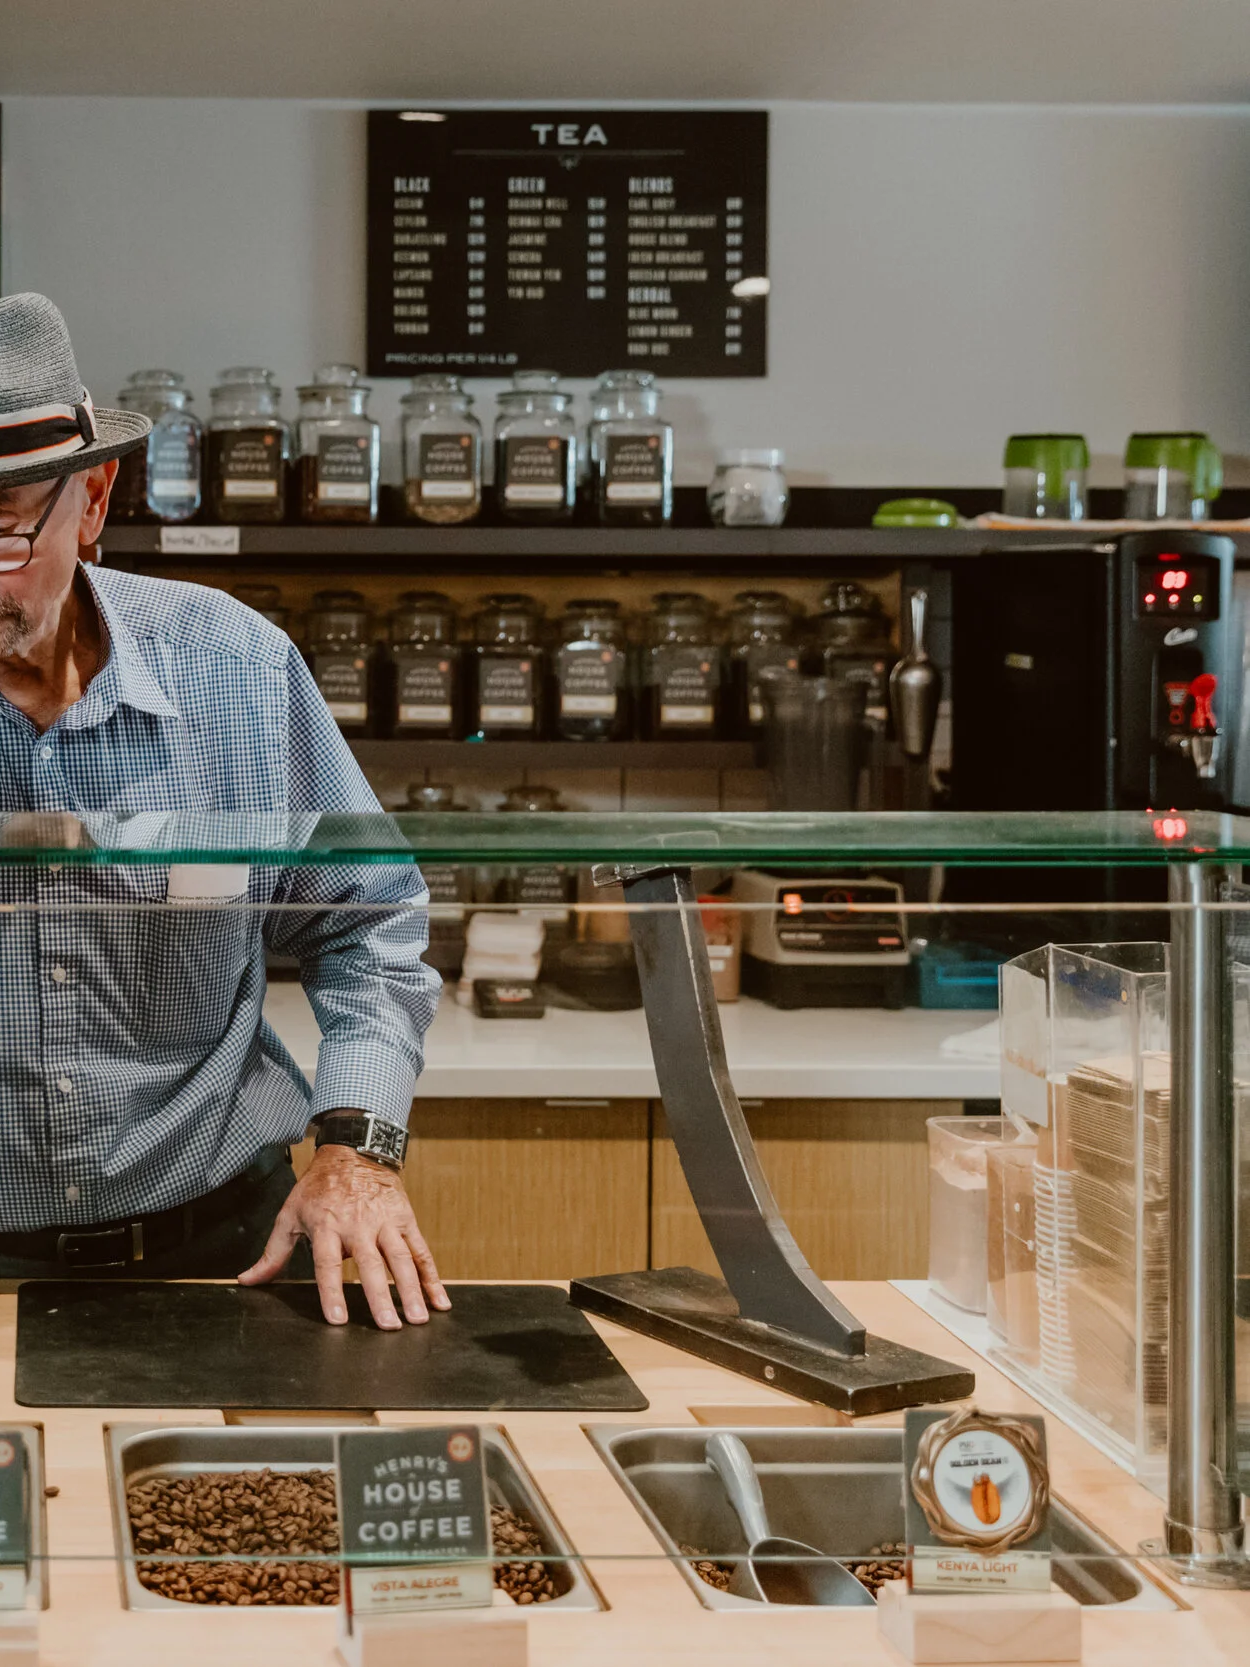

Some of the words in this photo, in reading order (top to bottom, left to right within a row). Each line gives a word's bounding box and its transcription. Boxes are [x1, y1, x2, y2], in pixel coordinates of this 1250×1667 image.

[530, 122, 609, 146] TEA
[393, 176, 430, 194] BLACK
[507, 176, 546, 194] GREEN
[628, 176, 673, 194] BLENDS
[373, 1455, 448, 1479] HENRY'S
[363, 1478, 463, 1506] HOUSE
[357, 1515, 474, 1543] COFFEE
[936, 1560, 979, 1572] KENYA
[982, 1561, 1020, 1573] LIGHT
[371, 1579, 408, 1592] VISTA
[411, 1576, 460, 1590] ALEGRE
